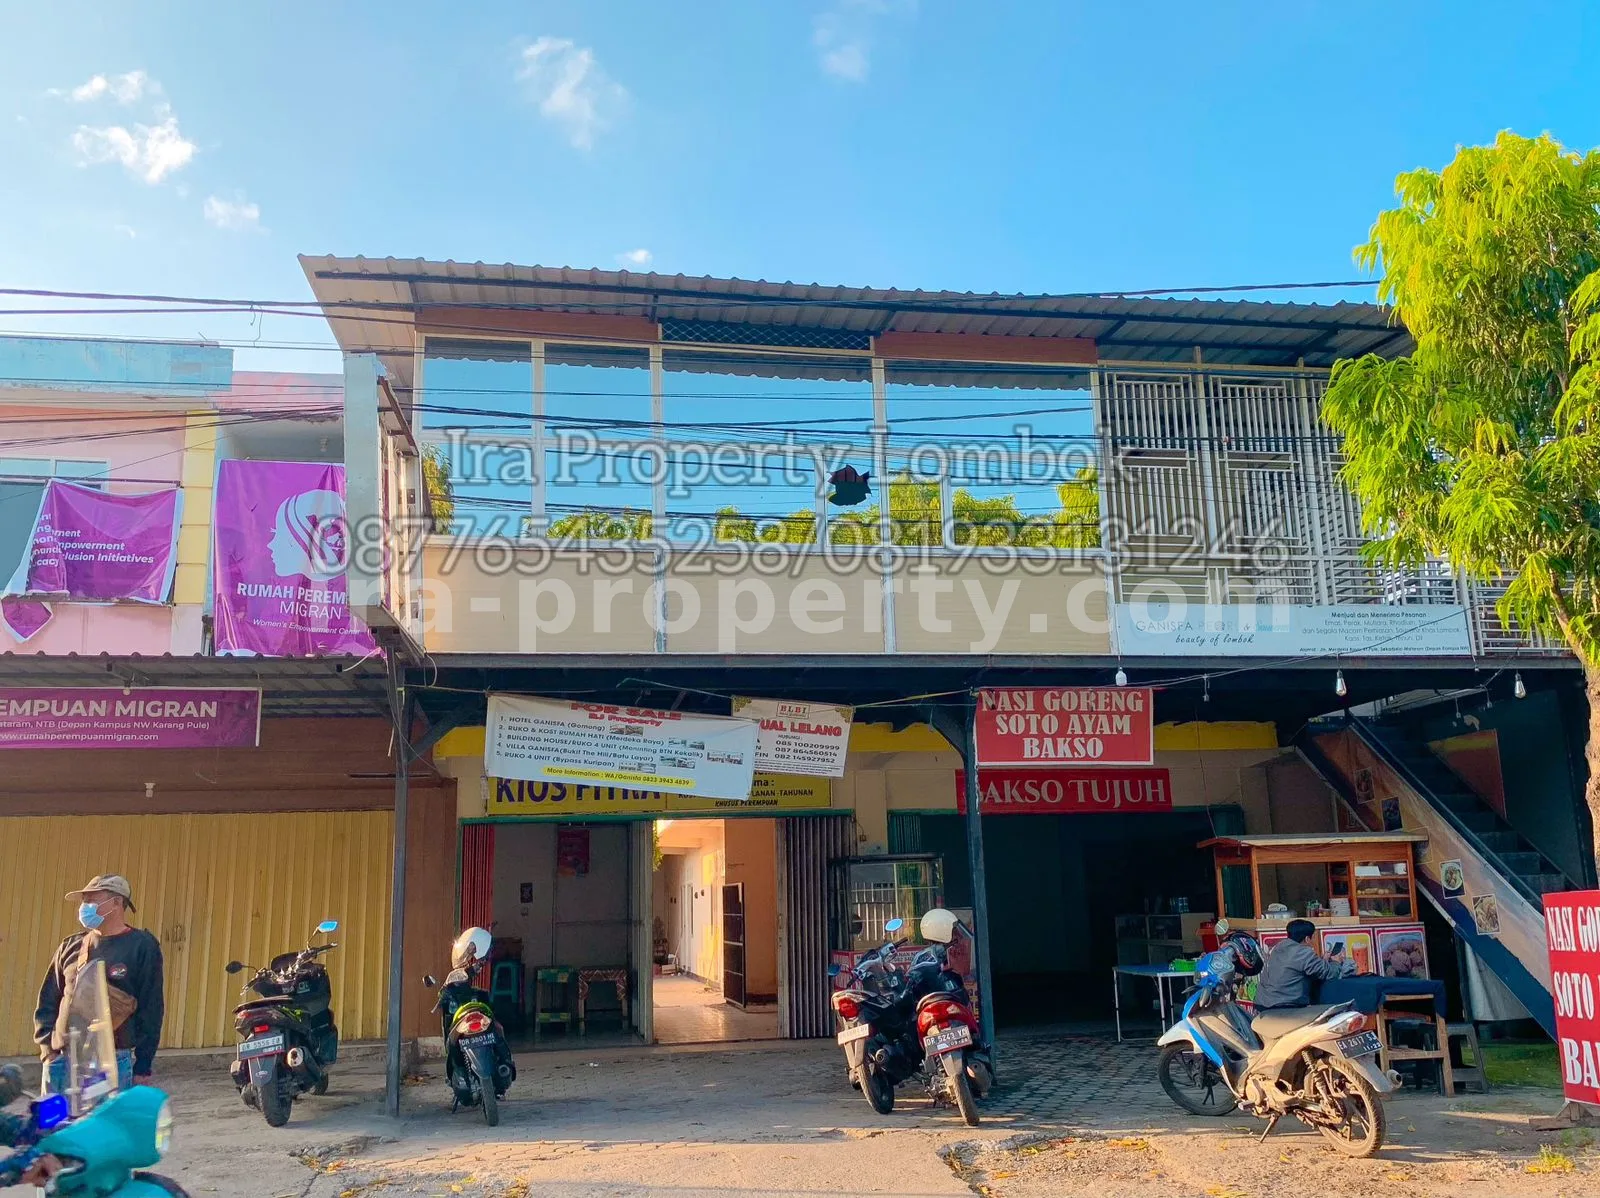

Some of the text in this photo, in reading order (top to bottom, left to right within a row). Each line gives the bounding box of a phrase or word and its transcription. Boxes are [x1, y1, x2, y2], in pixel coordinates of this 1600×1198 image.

[98, 553, 154, 563] Initiatives
[237, 582, 293, 599] RUMAH
[280, 601, 342, 620] MIGRAN
[253, 619, 287, 629] Women's
[289, 622, 337, 633] Empowerment
[1210, 634, 1219, 646] of
[0, 699, 218, 718] EMPUAN MIGRAN
[981, 690, 1144, 713] NASI GORENG
[571, 703, 682, 721] FOR SALE
[779, 704, 807, 714] BLBI
[36, 720, 56, 729] NTB
[58, 720, 91, 731] (Depan
[93, 720, 131, 730] Kampus
[133, 721, 151, 729] NW
[152, 721, 184, 731] Karang
[186, 721, 210, 731] Pule)
[790, 721, 842, 736] LELANG
[995, 713, 1131, 735] SOTO AYAM
[508, 725, 529, 733] RUKO
[559, 730, 586, 738] RUMAH
[507, 734, 541, 742] BUILDING
[543, 738, 593, 747] HOUSE/RUKO
[794, 741, 840, 751] 100209999
[583, 748, 595, 756] The
[1023, 737, 1104, 759] BAKSO
[504, 752, 526, 760] RUKO
[564, 769, 600, 777] Information
[1068, 779, 1166, 809] TUJUH
[740, 799, 778, 807] PEREMPUAN
[1546, 906, 1577, 952] NASI
[1554, 970, 1595, 1021] SOTO
[1561, 1037, 1600, 1088] BA
